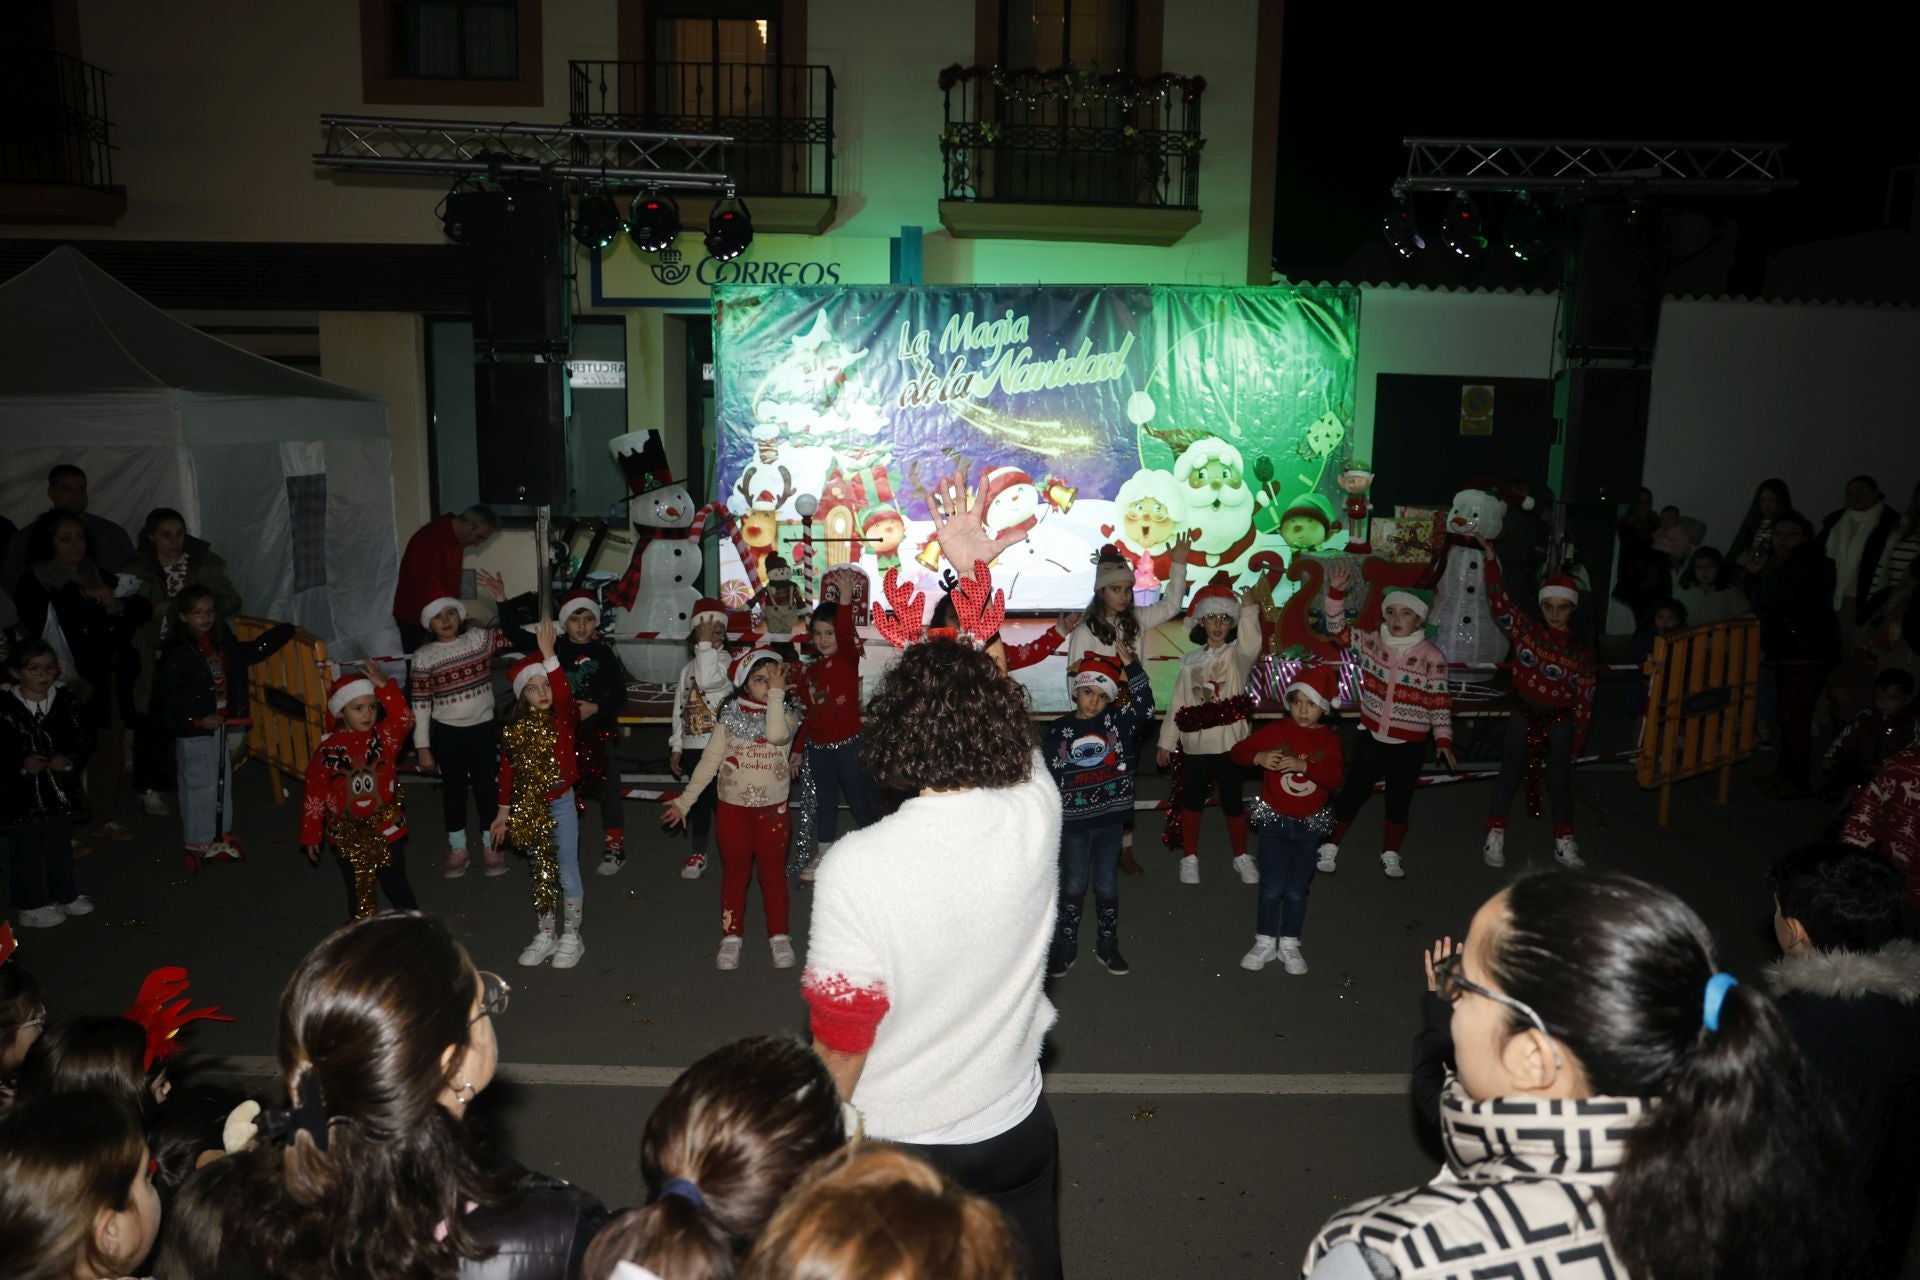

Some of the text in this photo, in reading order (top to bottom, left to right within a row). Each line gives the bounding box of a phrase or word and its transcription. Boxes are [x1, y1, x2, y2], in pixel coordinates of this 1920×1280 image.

[696, 257, 841, 285] CORREOS
[898, 309, 1029, 367] La Magia
[973, 330, 1136, 401] Navidad
